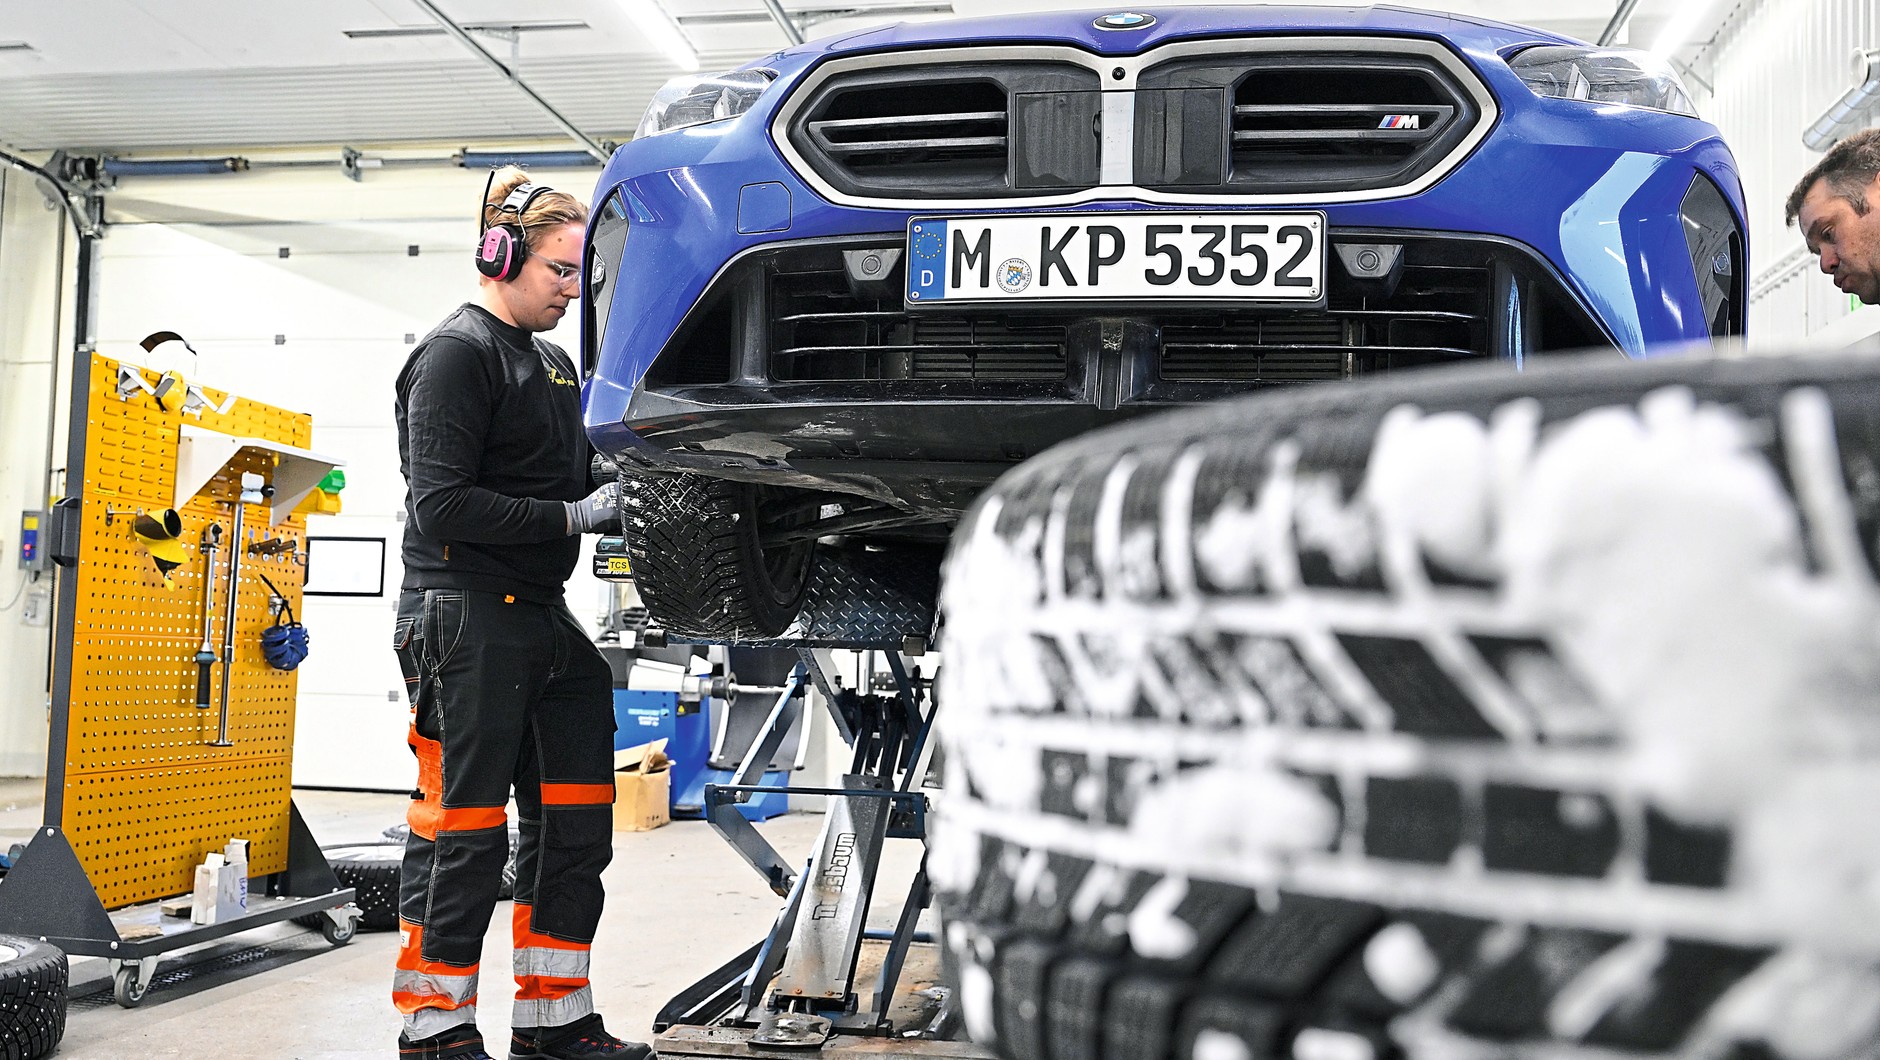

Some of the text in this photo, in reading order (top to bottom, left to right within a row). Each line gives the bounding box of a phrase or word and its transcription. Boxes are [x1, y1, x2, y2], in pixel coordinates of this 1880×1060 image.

[951, 228, 992, 288] M
[1039, 225, 1125, 287] KP
[1144, 224, 1314, 287] 5352
[920, 269, 934, 287] D
[610, 561, 627, 569] TCS
